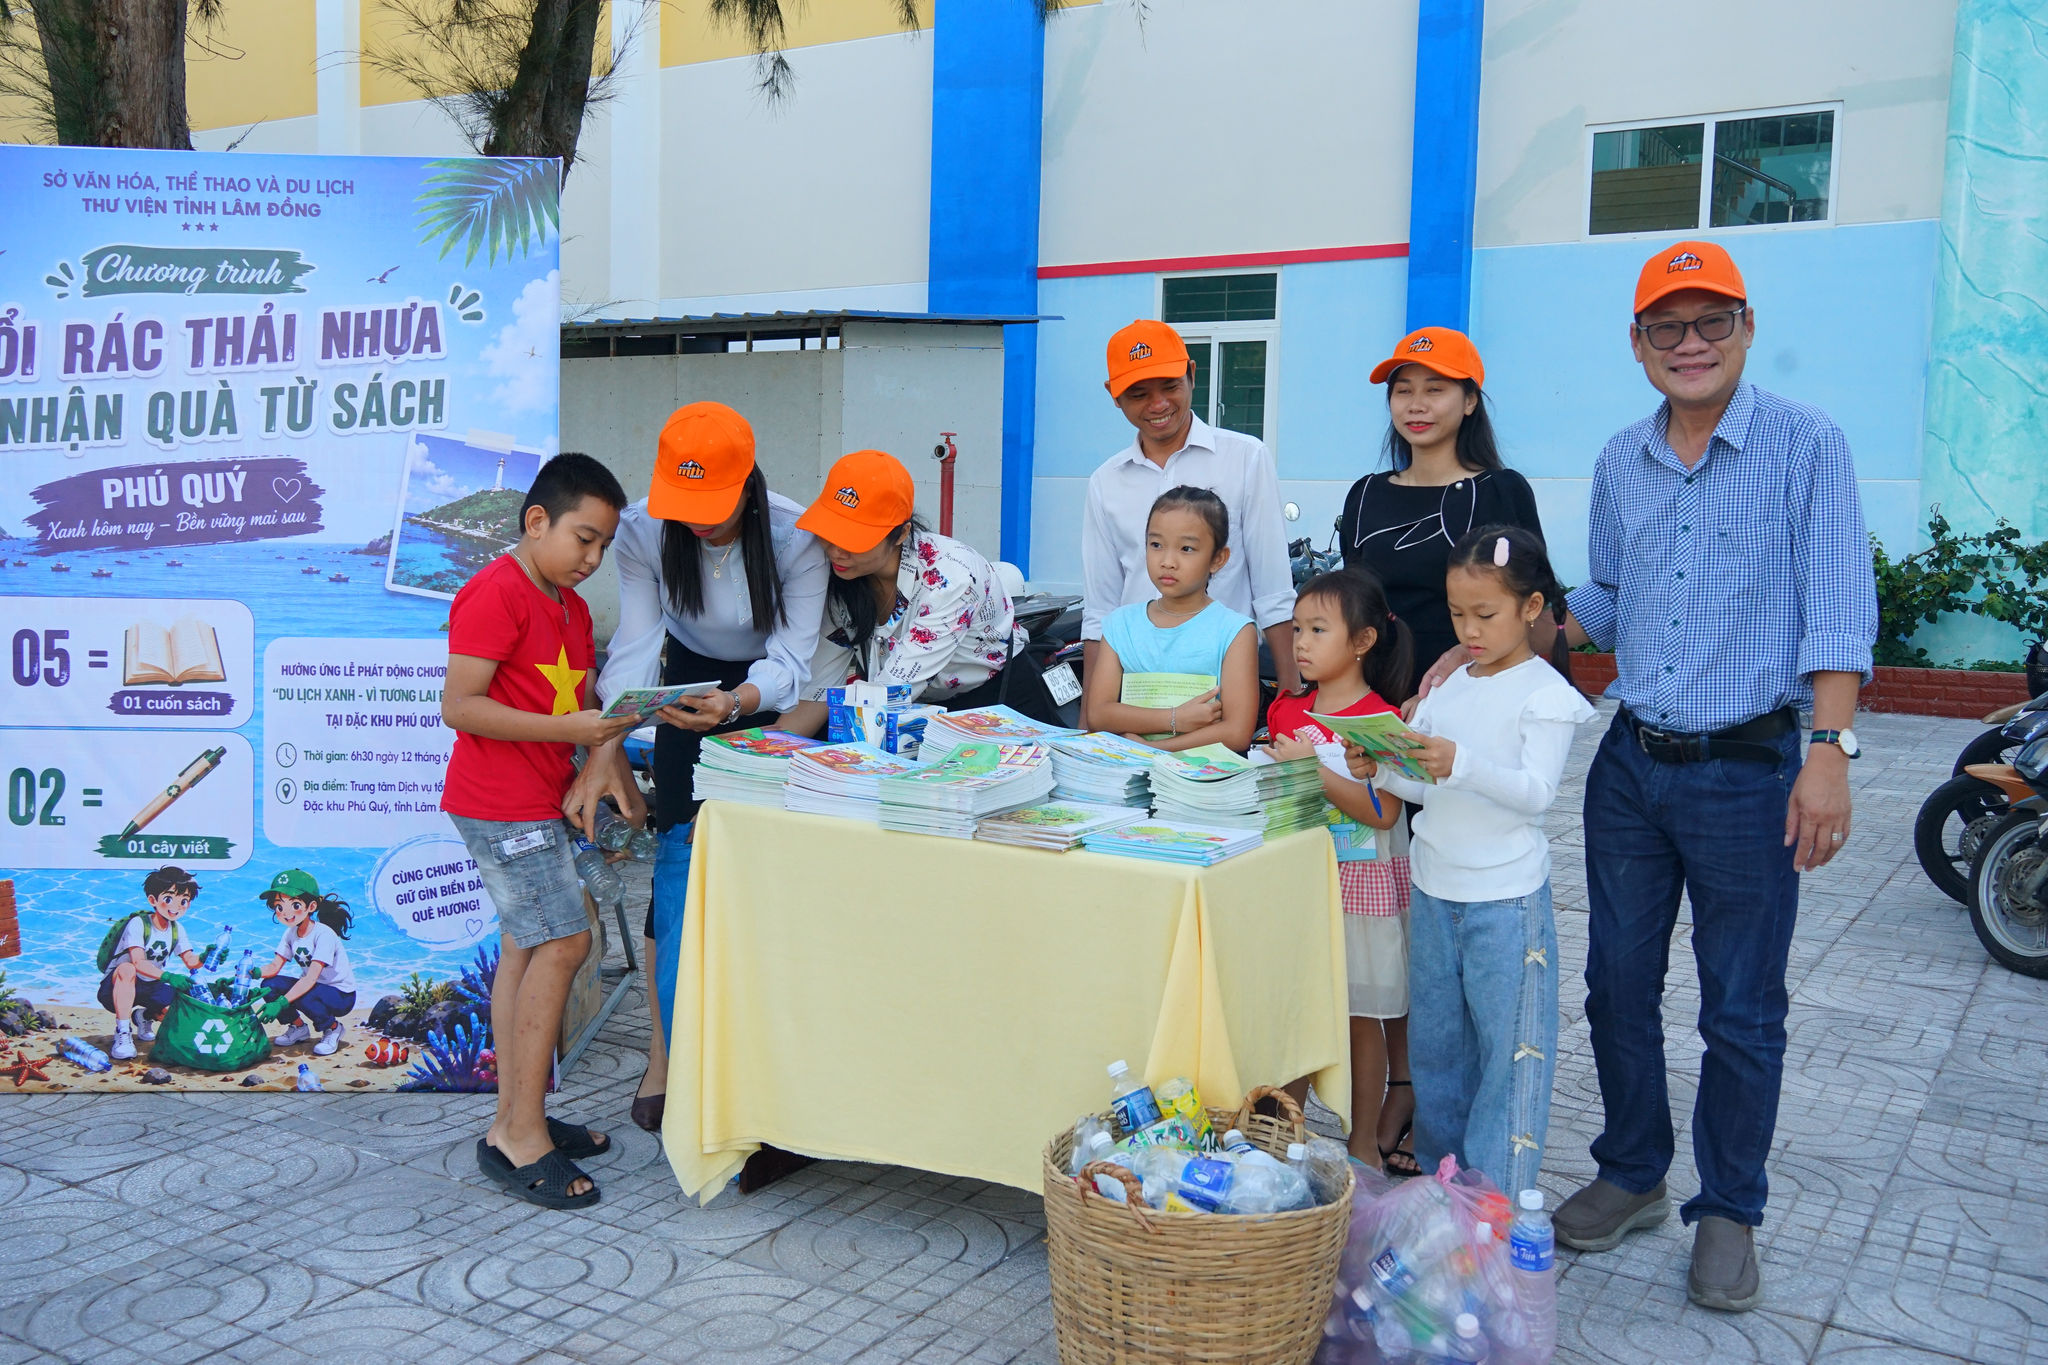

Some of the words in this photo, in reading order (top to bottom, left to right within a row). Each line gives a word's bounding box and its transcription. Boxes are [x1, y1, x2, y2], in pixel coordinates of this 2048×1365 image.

[43, 168, 68, 188] SỞ
[72, 170, 111, 189] VĂN
[116, 171, 160, 193] HÓA,
[165, 170, 198, 191] THỂ
[203, 176, 251, 193] THAO
[256, 174, 281, 194] VÀ
[286, 178, 310, 194] DU
[316, 179, 354, 198] LỊCH
[82, 196, 121, 213] THƯ
[124, 195, 168, 218] VIỆN
[173, 195, 216, 215] TỈNH
[222, 198, 261, 216] LÂM
[267, 196, 322, 218] ĐỒNG
[96, 252, 209, 295] Chương
[215, 257, 286, 286] trình
[0, 307, 36, 378] ỔI
[63, 312, 164, 375] RÁC
[185, 302, 297, 369] THẢI
[321, 302, 442, 361] NHỰA
[0, 385, 124, 452] NHẬN
[147, 379, 238, 444] QUÀ
[260, 376, 318, 433] TỪ
[332, 372, 445, 430] SÁCH
[102, 468, 170, 509] PHÚ
[181, 464, 248, 509] QUÝ
[47, 521, 88, 541] Xanh
[92, 519, 123, 537] hôm
[127, 521, 155, 541] nay
[176, 511, 206, 533] Bền
[210, 511, 247, 535] vững
[250, 509, 278, 526] mai
[281, 509, 307, 525] sau
[12, 628, 71, 687] 05
[281, 662, 317, 676] HƯỞNG
[319, 662, 341, 677] ỨNG
[343, 661, 355, 677] LỄ
[357, 663, 383, 677] PHÁT
[386, 664, 414, 679] ĐỘNG
[416, 665, 447, 678] CHƯƠ
[123, 696, 142, 710] 01
[146, 694, 183, 710] cuốn
[186, 696, 221, 711] sách
[297, 688, 322, 704] LỊCH
[325, 688, 356, 702] XANH
[365, 686, 377, 702] VÌ
[379, 688, 416, 702] TƯƠNG
[419, 690, 436, 702] LAI
[326, 714, 343, 729] TẠI
[345, 712, 368, 730] ĐẶC
[371, 715, 393, 727] KHU
[395, 712, 417, 727] PHÚ
[420, 712, 442, 728] QUÝ
[304, 750, 323, 761] Thời
[325, 750, 349, 764] gian:
[350, 750, 374, 762] 6h30
[375, 751, 400, 765] ngày
[401, 751, 412, 762] 12
[414, 751, 441, 765] tháng
[443, 751, 449, 762] 6
[9, 767, 66, 826] 02
[303, 780, 320, 793] Địa
[321, 778, 348, 791] điểm:
[350, 780, 376, 795] Trung
[377, 781, 396, 792] tâm
[398, 781, 419, 795] Dịch
[421, 784, 432, 795] vụ
[434, 779, 445, 793] tổ
[303, 800, 324, 814] Đặc
[326, 800, 345, 811] khu
[347, 800, 367, 811] Phú
[369, 800, 391, 814] Quý,
[394, 800, 413, 812] tỉnh
[415, 801, 437, 813] Lâm
[127, 840, 147, 854] 01
[151, 840, 177, 857] cây
[181, 838, 210, 854] viết
[392, 870, 424, 885] CÙNG
[425, 861, 464, 879] CHUNG
[396, 889, 416, 906] GIỮ
[418, 886, 438, 901] GÌN
[440, 879, 466, 897] BIỂN
[467, 875, 485, 892] ĐẢ
[412, 905, 435, 923] QUÊ
[436, 899, 481, 918] HƯƠNG!
